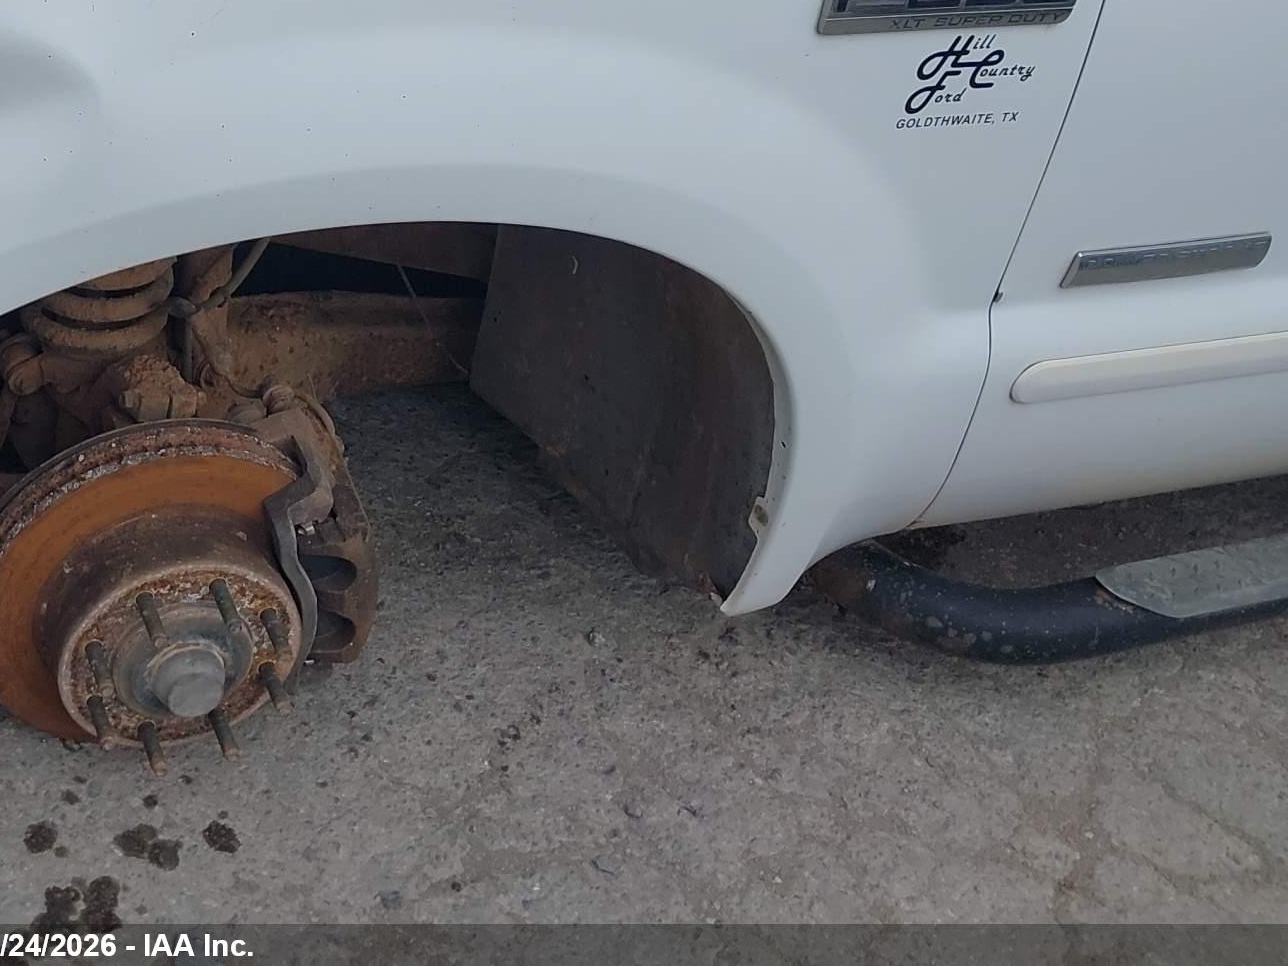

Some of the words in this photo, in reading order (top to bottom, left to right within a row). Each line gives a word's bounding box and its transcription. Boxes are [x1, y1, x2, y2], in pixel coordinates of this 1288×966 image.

[891, 17, 926, 30] XLT
[934, 13, 1003, 28] SUPER
[1008, 11, 1067, 24] DUTY
[917, 34, 996, 80] Hill
[969, 49, 1035, 88] Country
[896, 113, 995, 129] GOLDTHWAITE,
[1002, 111, 1019, 123] TX
